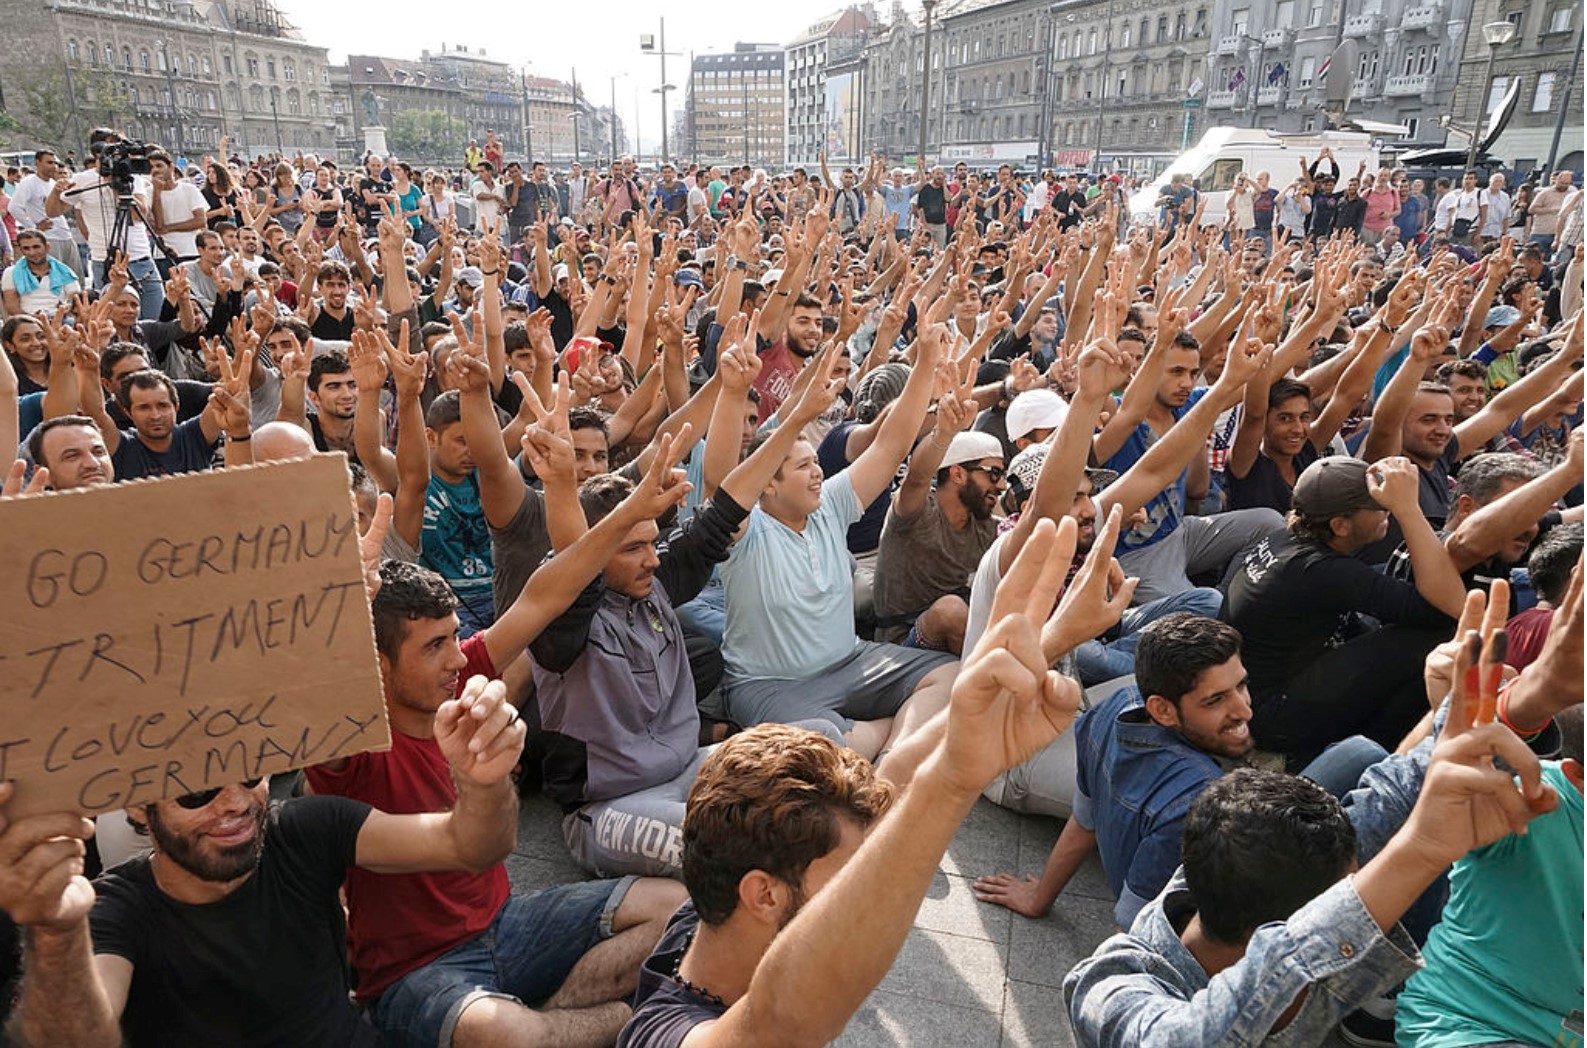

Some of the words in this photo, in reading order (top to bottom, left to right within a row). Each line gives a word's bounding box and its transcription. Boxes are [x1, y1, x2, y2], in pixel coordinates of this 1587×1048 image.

[26, 549, 108, 608] GO
[137, 513, 358, 585] GERMANY
[79, 714, 379, 810] GERMANY
